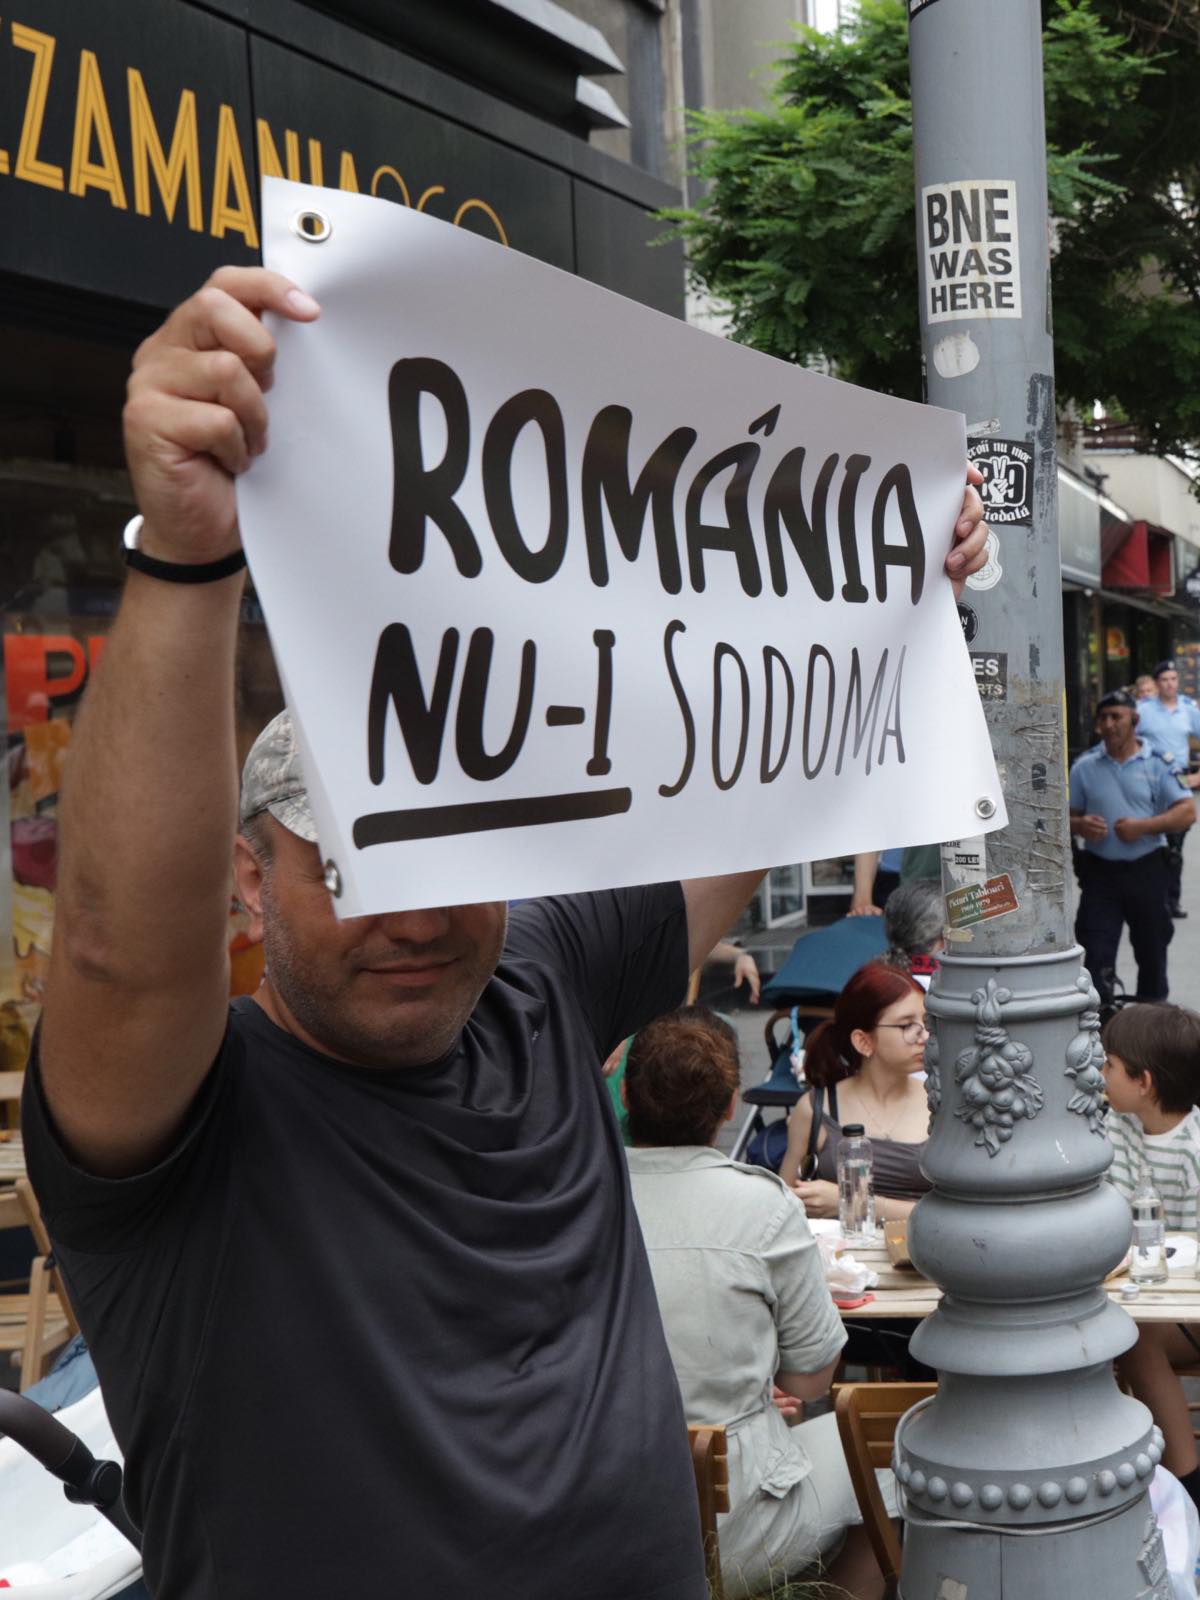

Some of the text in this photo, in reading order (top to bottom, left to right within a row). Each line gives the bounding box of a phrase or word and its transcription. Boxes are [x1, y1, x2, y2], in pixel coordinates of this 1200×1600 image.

[927, 189, 1011, 248] BNE
[930, 248, 1012, 280] WAS
[931, 282, 1014, 314] HERE
[993, 442, 1008, 453] nu
[1011, 446, 1032, 463] mor
[388, 357, 926, 606] ROMÂNIA
[972, 658, 999, 676] ES
[977, 684, 1003, 695] RTS
[367, 619, 907, 798] NU-I SODOMA
[955, 856, 967, 864] 200
